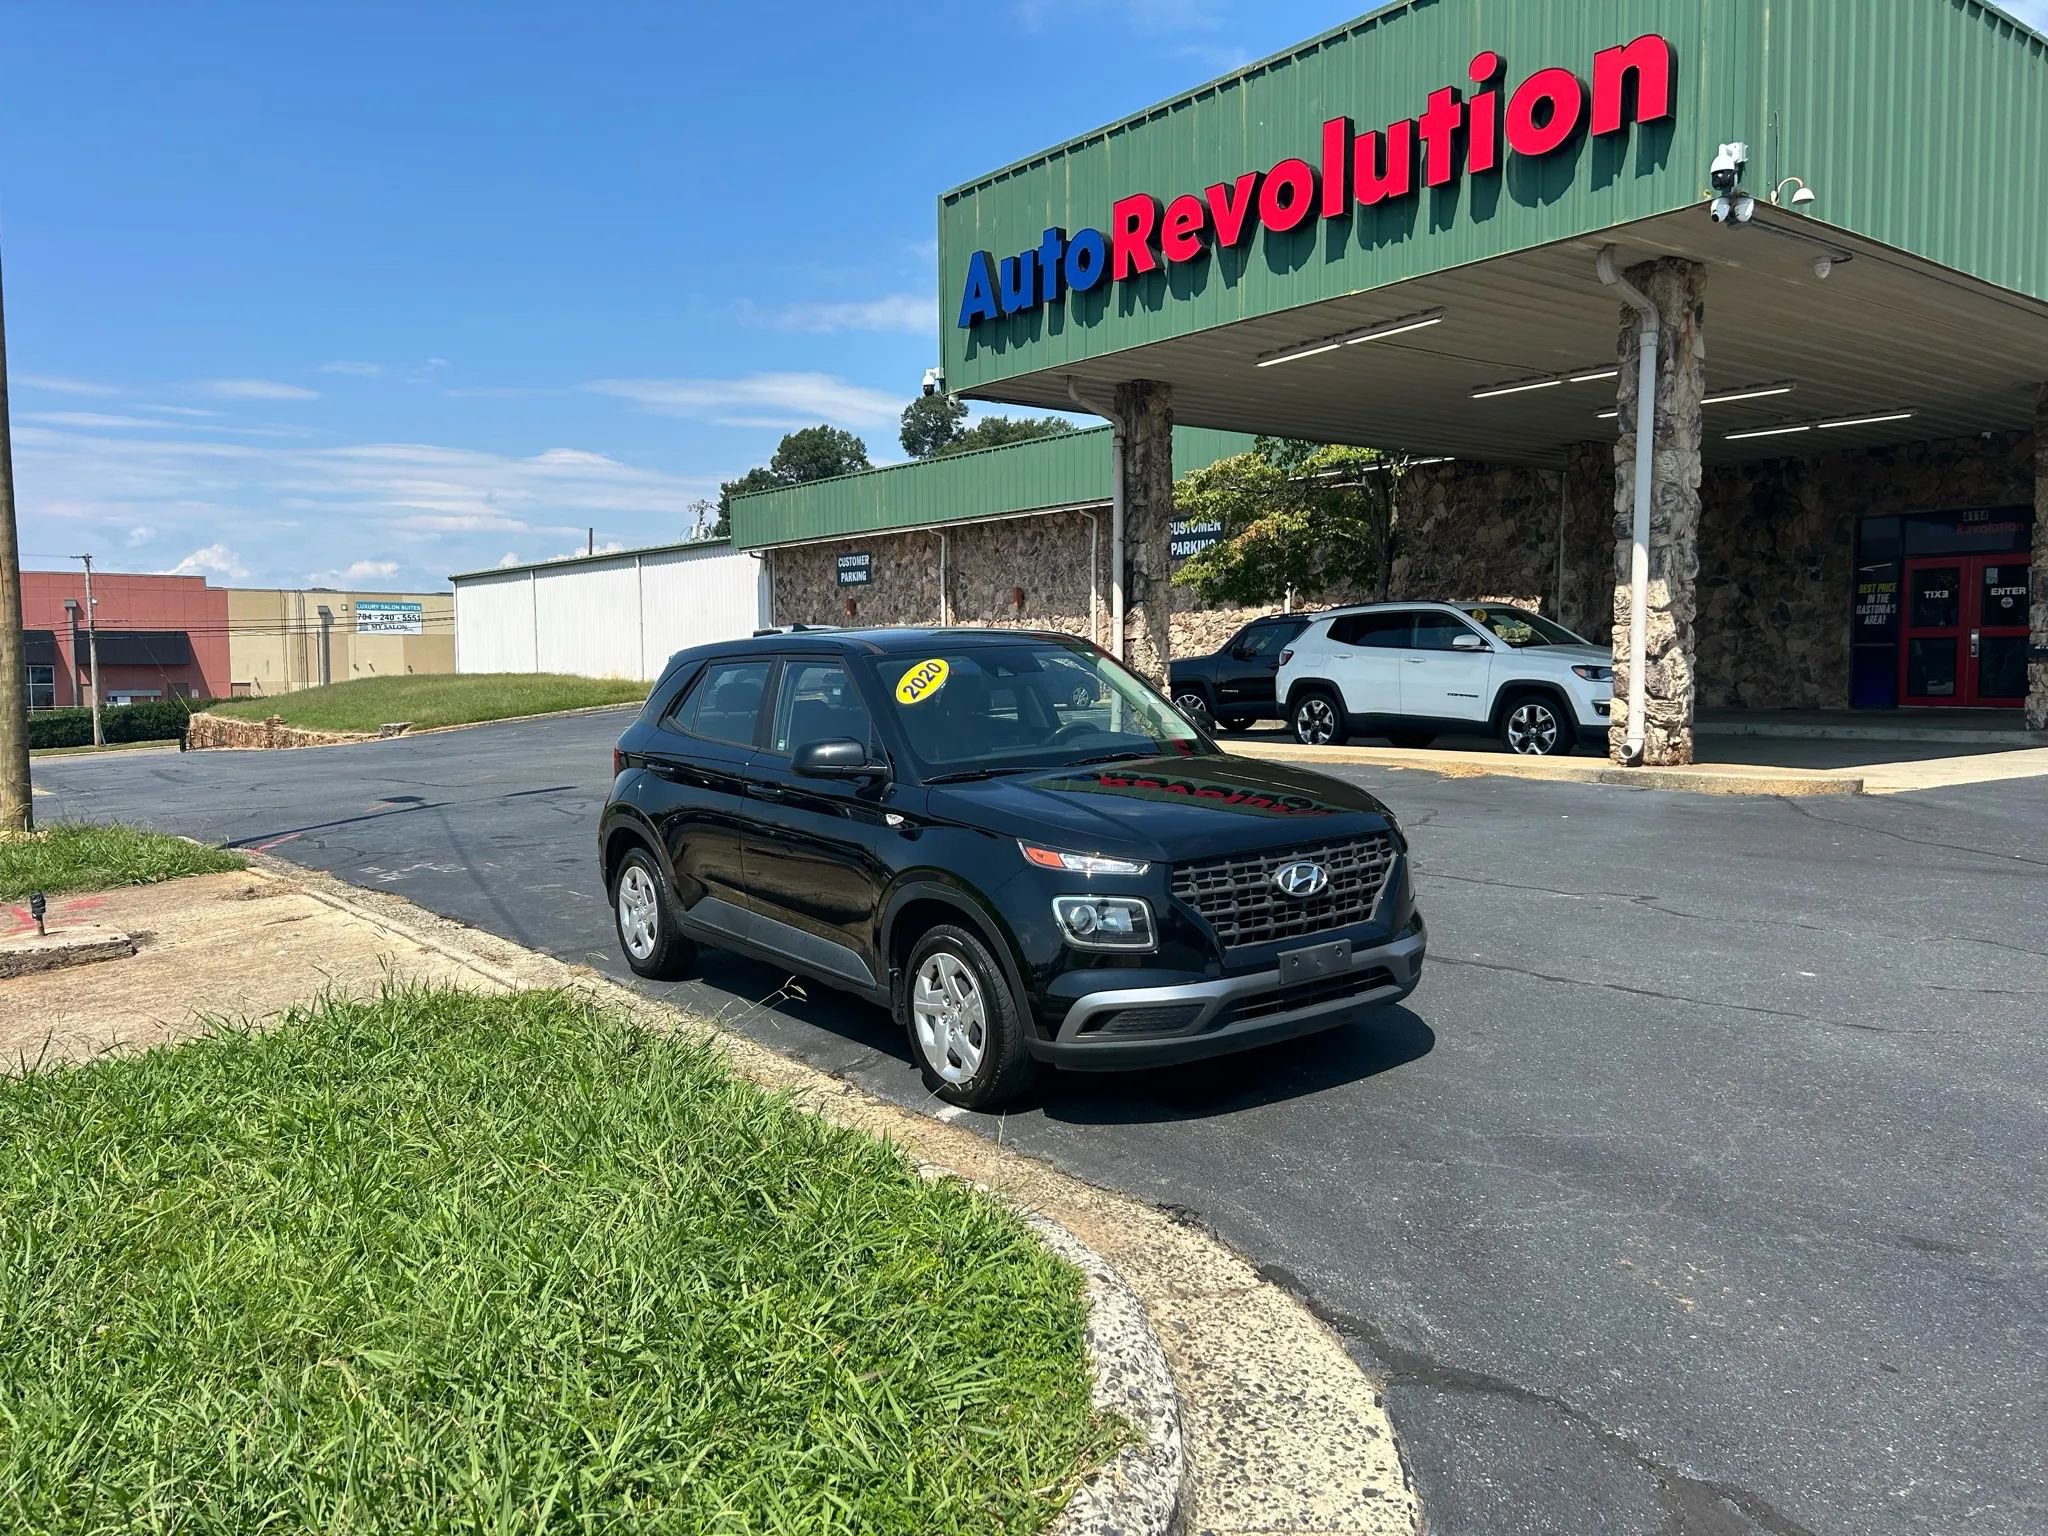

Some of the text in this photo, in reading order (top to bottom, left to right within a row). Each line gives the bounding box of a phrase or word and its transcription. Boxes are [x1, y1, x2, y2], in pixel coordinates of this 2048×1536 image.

[838, 555, 869, 567] CUSTOMER
[840, 570, 867, 582] PARKING
[1858, 582, 1898, 593] BEST PRICE
[1990, 587, 2026, 595] ENTER
[1867, 593, 1890, 604] IN THE
[380, 613, 394, 621] 240
[1864, 615, 1887, 625] AREA!
[903, 662, 942, 699] 2020
